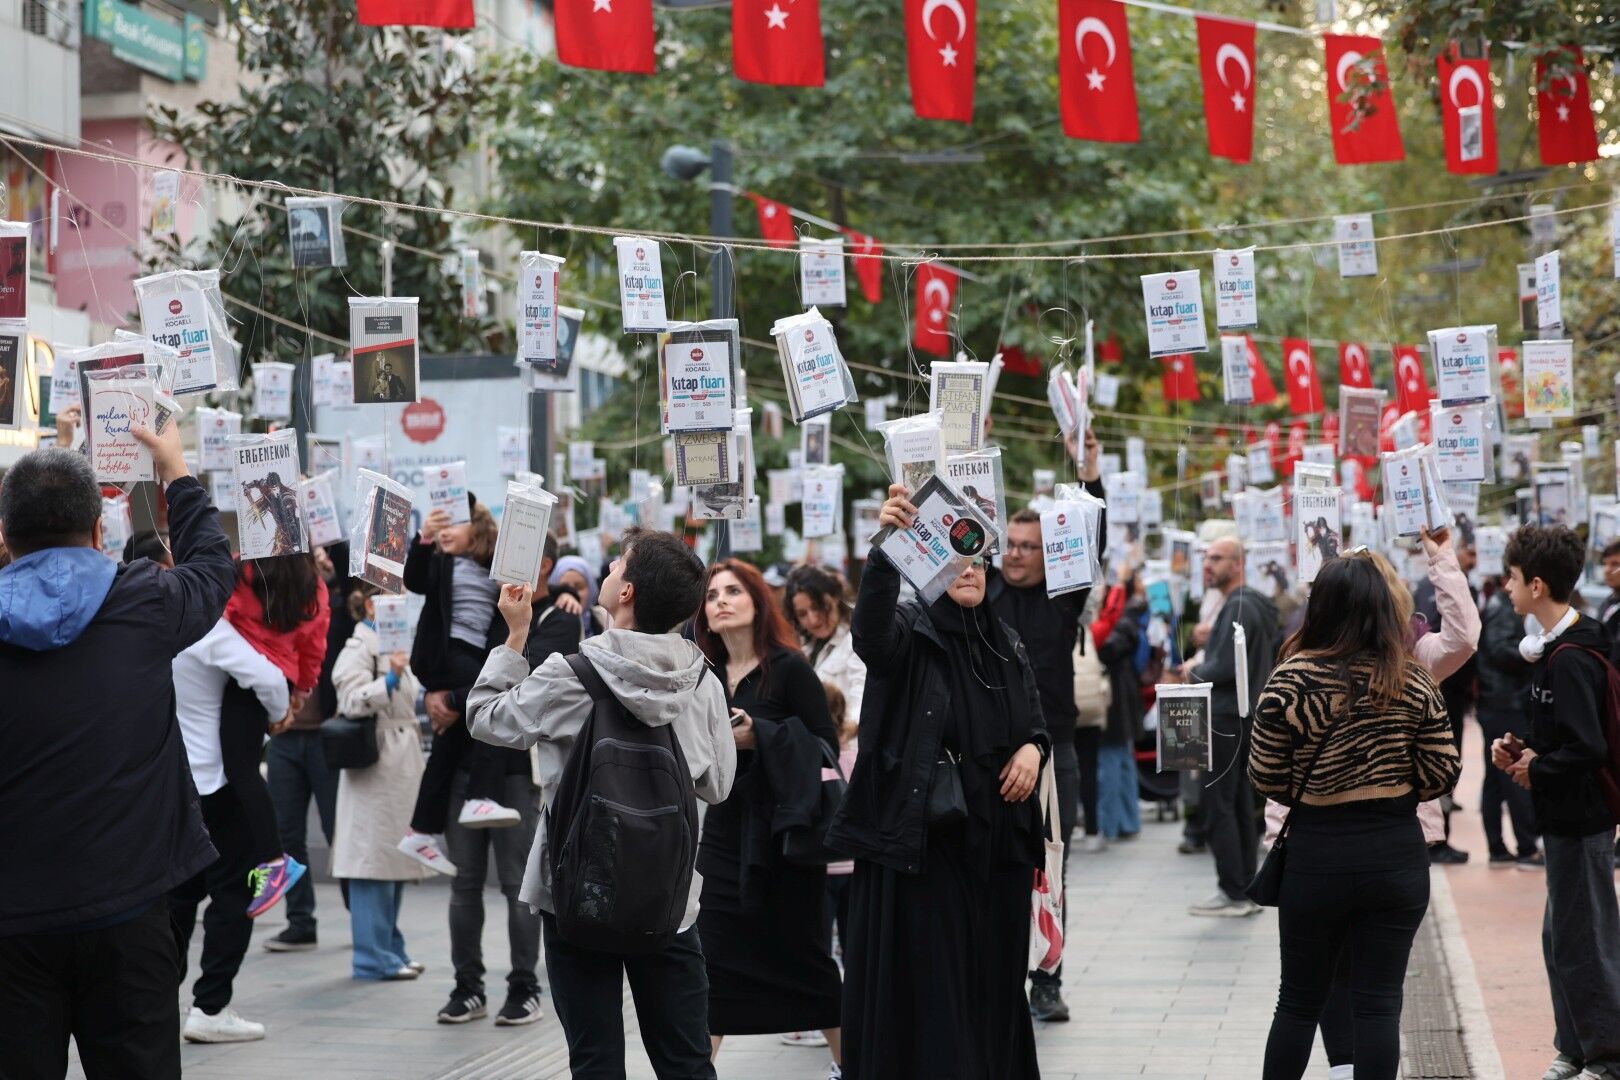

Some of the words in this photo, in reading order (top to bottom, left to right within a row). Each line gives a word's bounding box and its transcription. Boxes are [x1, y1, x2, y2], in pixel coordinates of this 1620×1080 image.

[700, 375, 725, 389] fuarı
[96, 406, 128, 422] milan
[105, 420, 131, 437] kund
[684, 432, 718, 445] ZWEIG
[240, 443, 290, 464] ERGENEKON
[1169, 709, 1198, 717] KAPAK
[1176, 719, 1192, 727] KIZI
